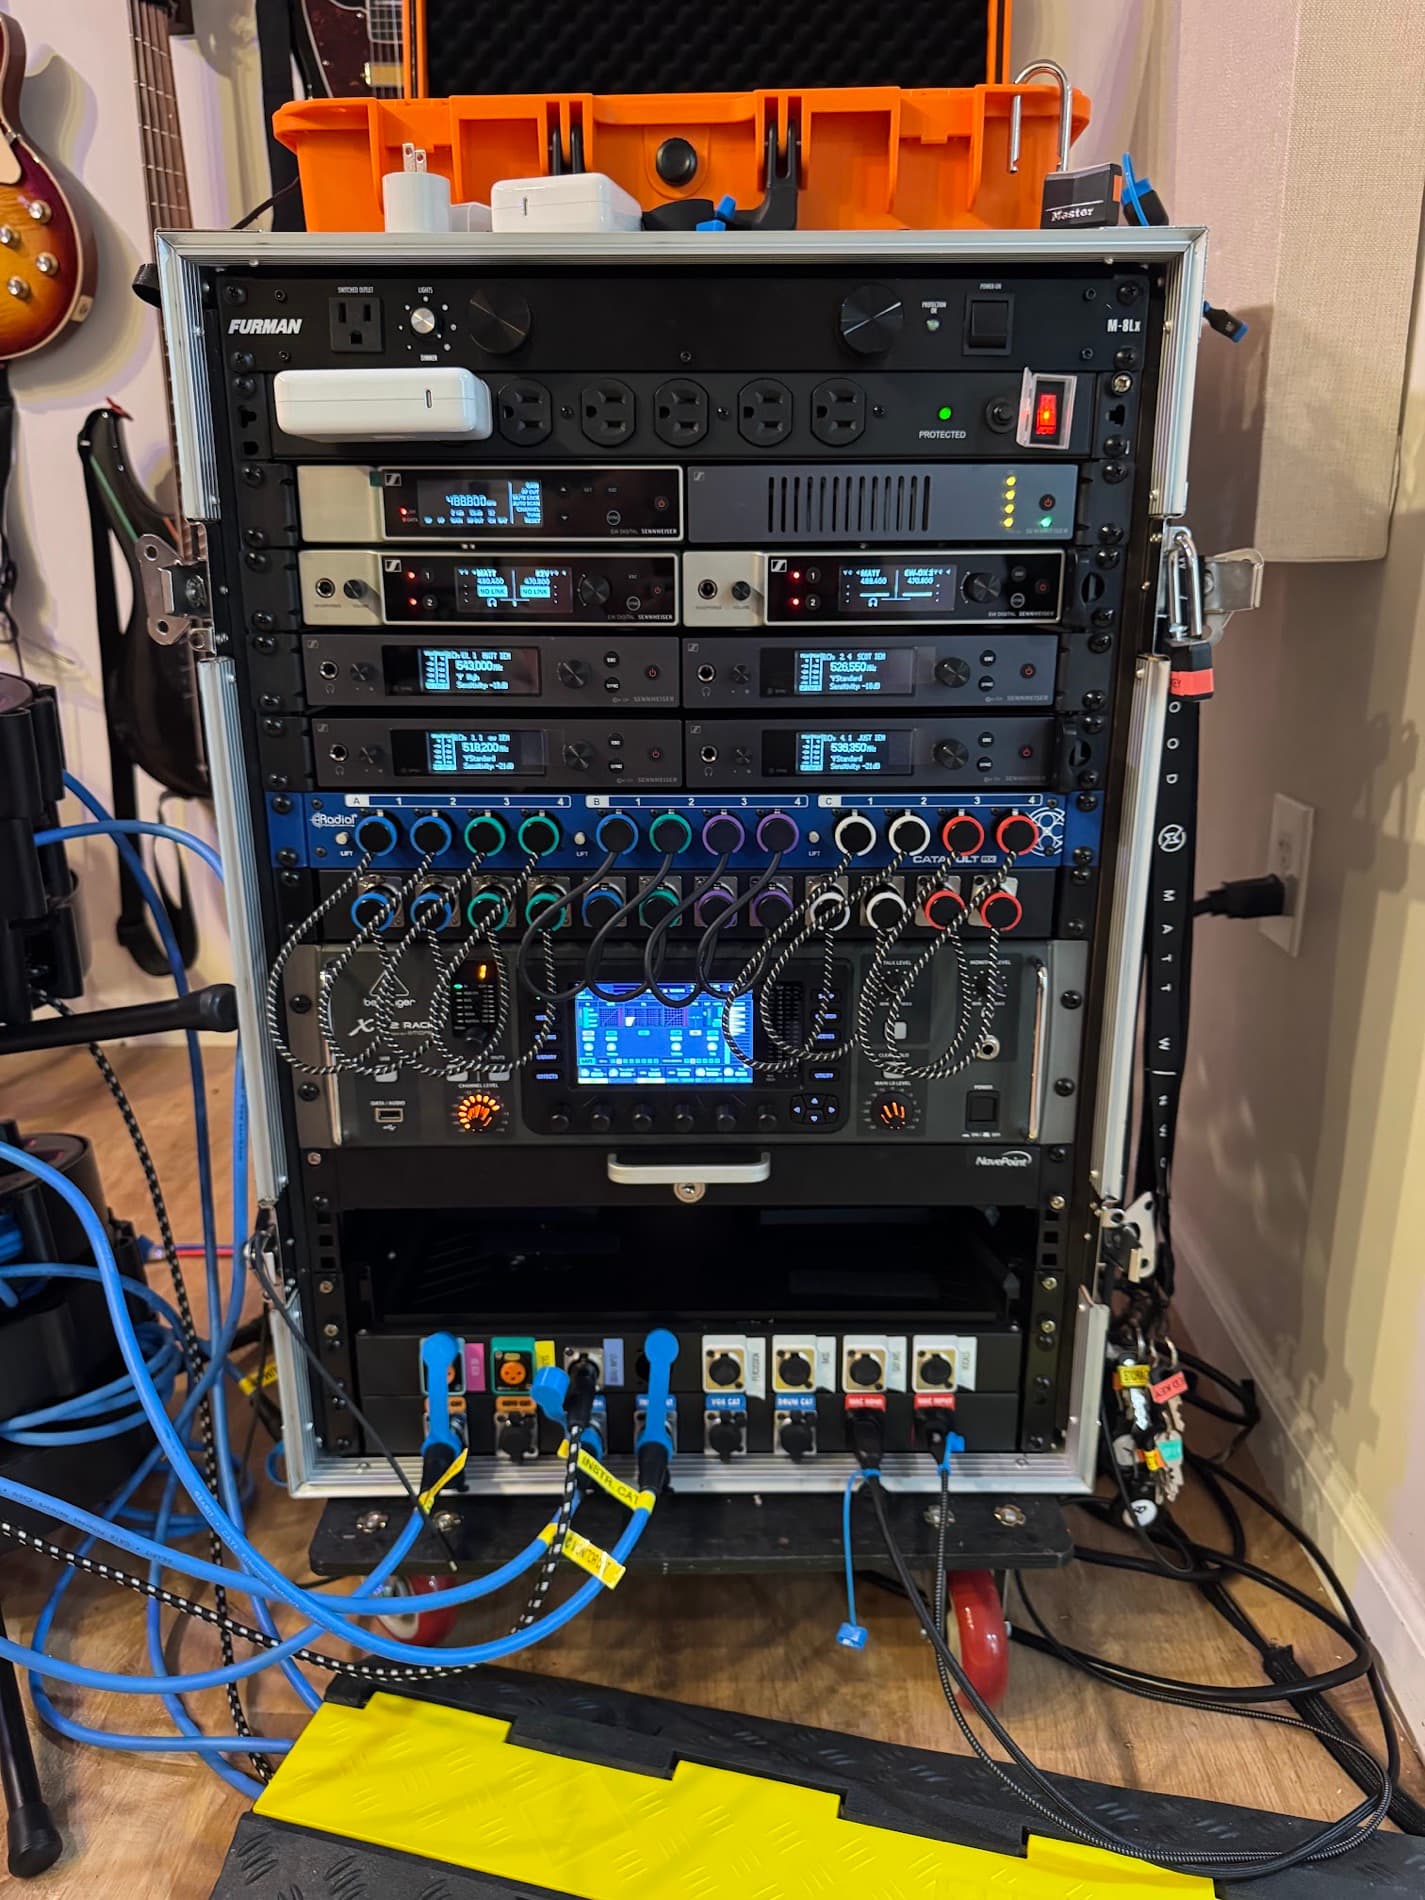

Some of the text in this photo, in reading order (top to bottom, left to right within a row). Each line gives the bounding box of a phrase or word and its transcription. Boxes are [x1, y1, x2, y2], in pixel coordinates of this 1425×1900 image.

[228, 318, 302, 335] FURMAN
[1107, 318, 1141, 333] M-8Lx
[918, 430, 966, 439] PROTECTED
[353, 797, 564, 806] A 1 2 3 4
[593, 797, 801, 806] B 1 2 3 4
[867, 797, 873, 805] 1
[920, 797, 927, 805] 2
[973, 797, 981, 805] 3
[1027, 796, 1035, 805] 4
[320, 813, 355, 825] Radial
[912, 855, 979, 864] CATAULT
[480, 964, 487, 979] 1
[363, 998, 416, 1009] beger
[348, 1017, 400, 1037] X2
[975, 1156, 1029, 1167] NavePoint
[581, 1455, 613, 1489] INSTR.
